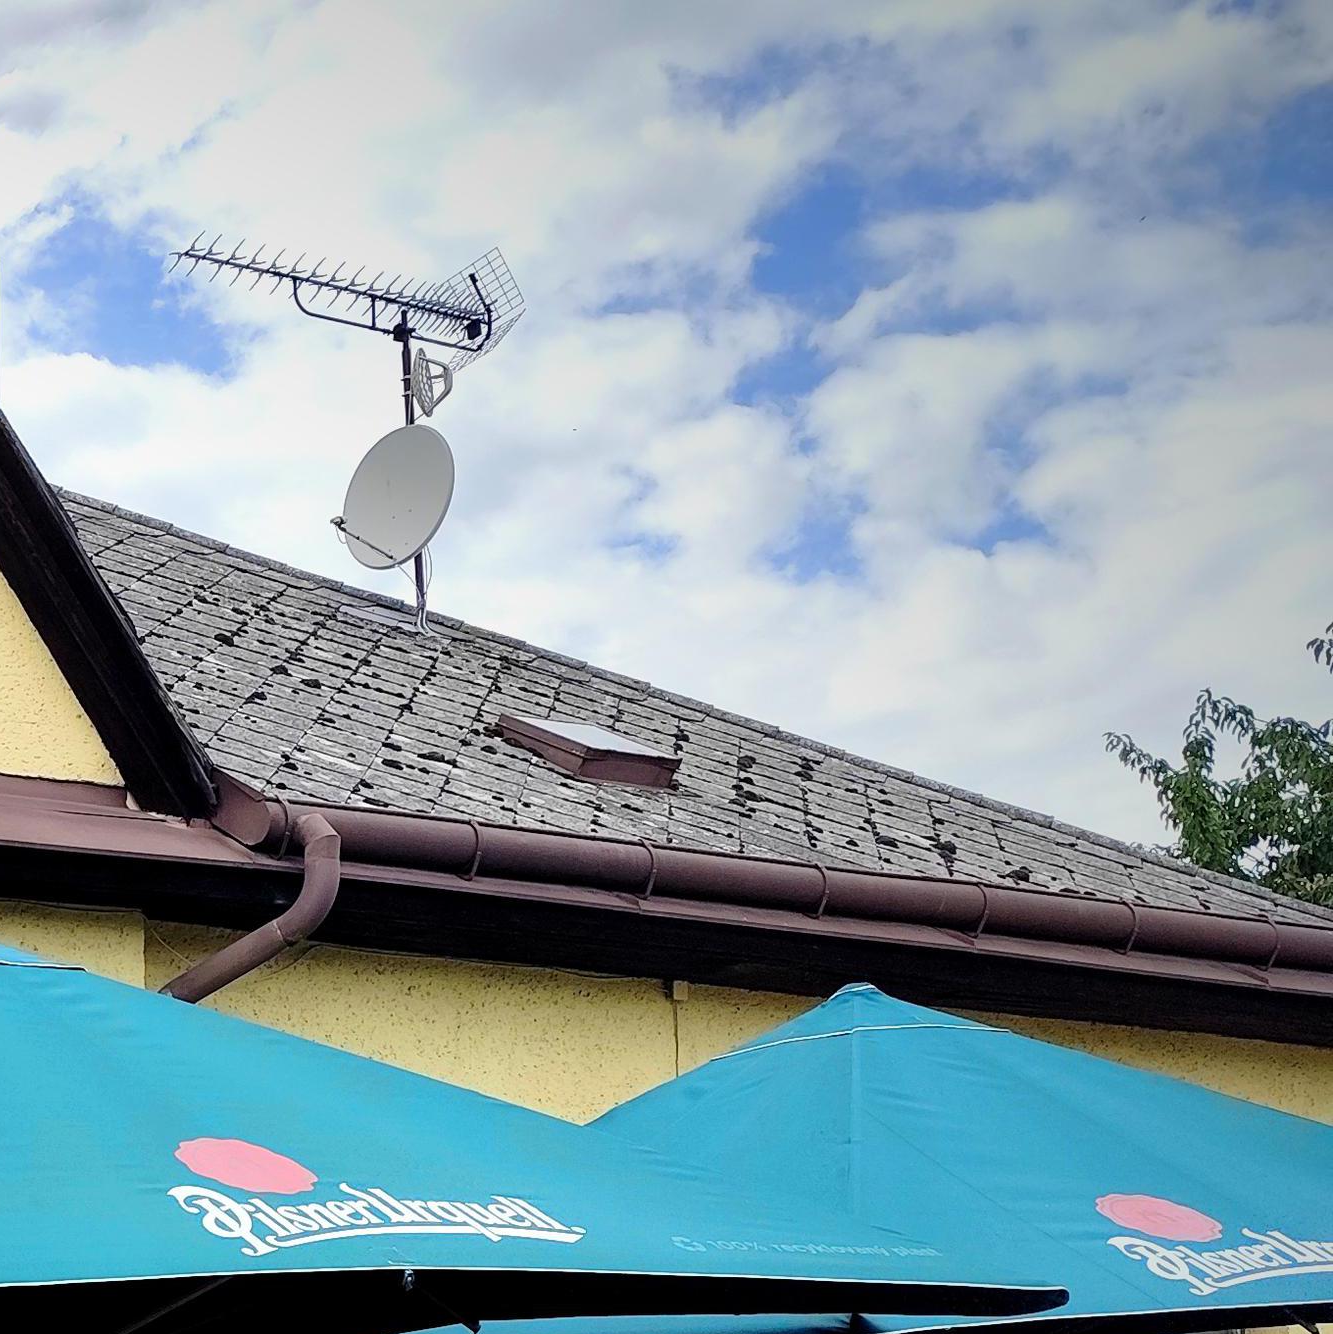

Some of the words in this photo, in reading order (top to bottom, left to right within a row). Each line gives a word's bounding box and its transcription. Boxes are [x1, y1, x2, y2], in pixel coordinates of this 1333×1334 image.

[165, 1185, 381, 1257] Pilsner
[339, 1182, 571, 1242] Urquell
[1106, 1235, 1288, 1296] Pilsner
